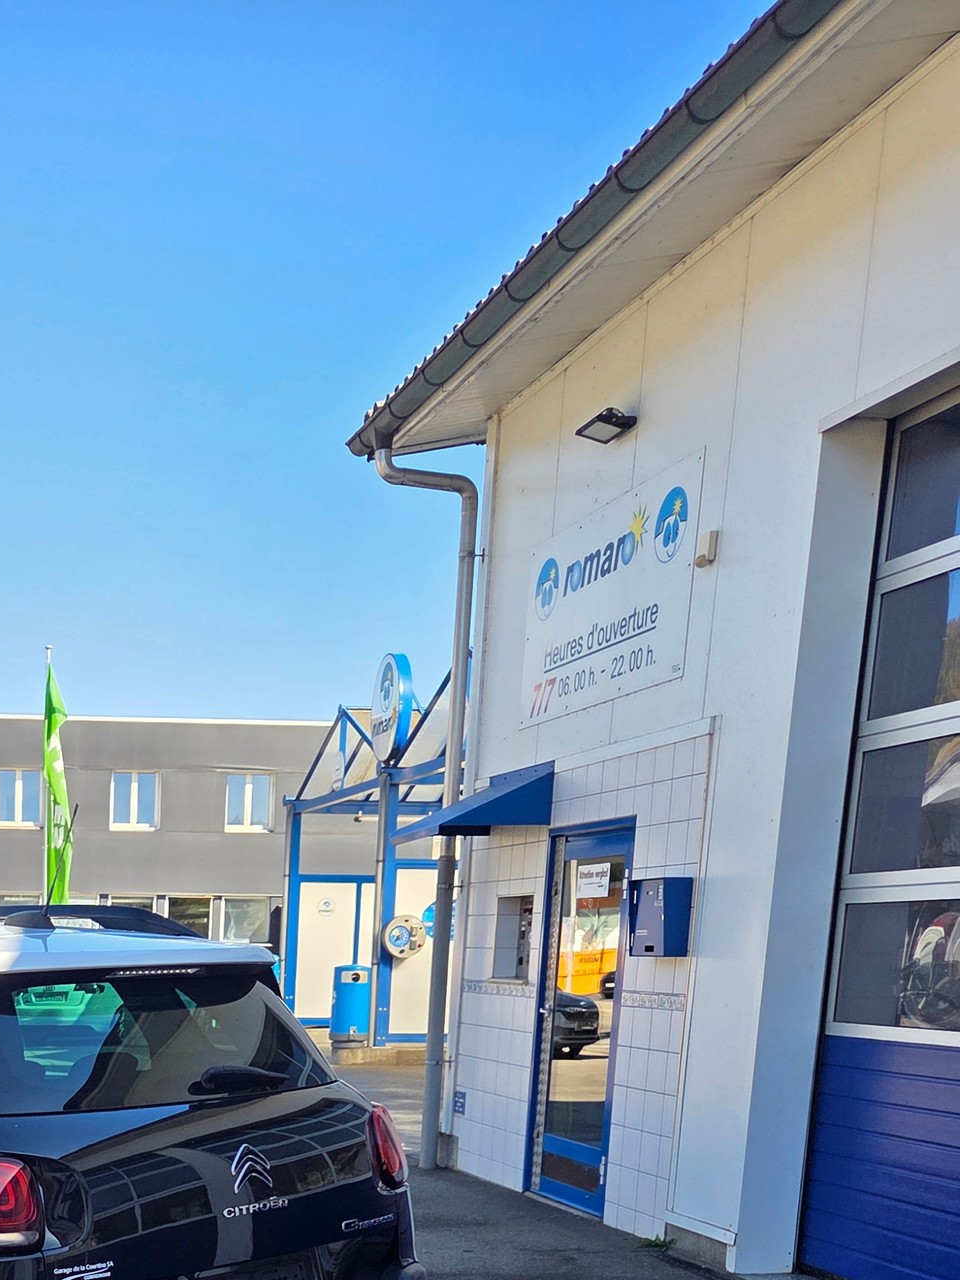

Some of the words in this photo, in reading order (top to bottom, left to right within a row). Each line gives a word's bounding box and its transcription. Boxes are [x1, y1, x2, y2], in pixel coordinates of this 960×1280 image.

[563, 531, 636, 597] romaro
[544, 635, 584, 668] Heures
[587, 603, 659, 650] d'ouverture
[529, 676, 557, 718] 7/7
[223, 1196, 288, 1218] CITROËN
